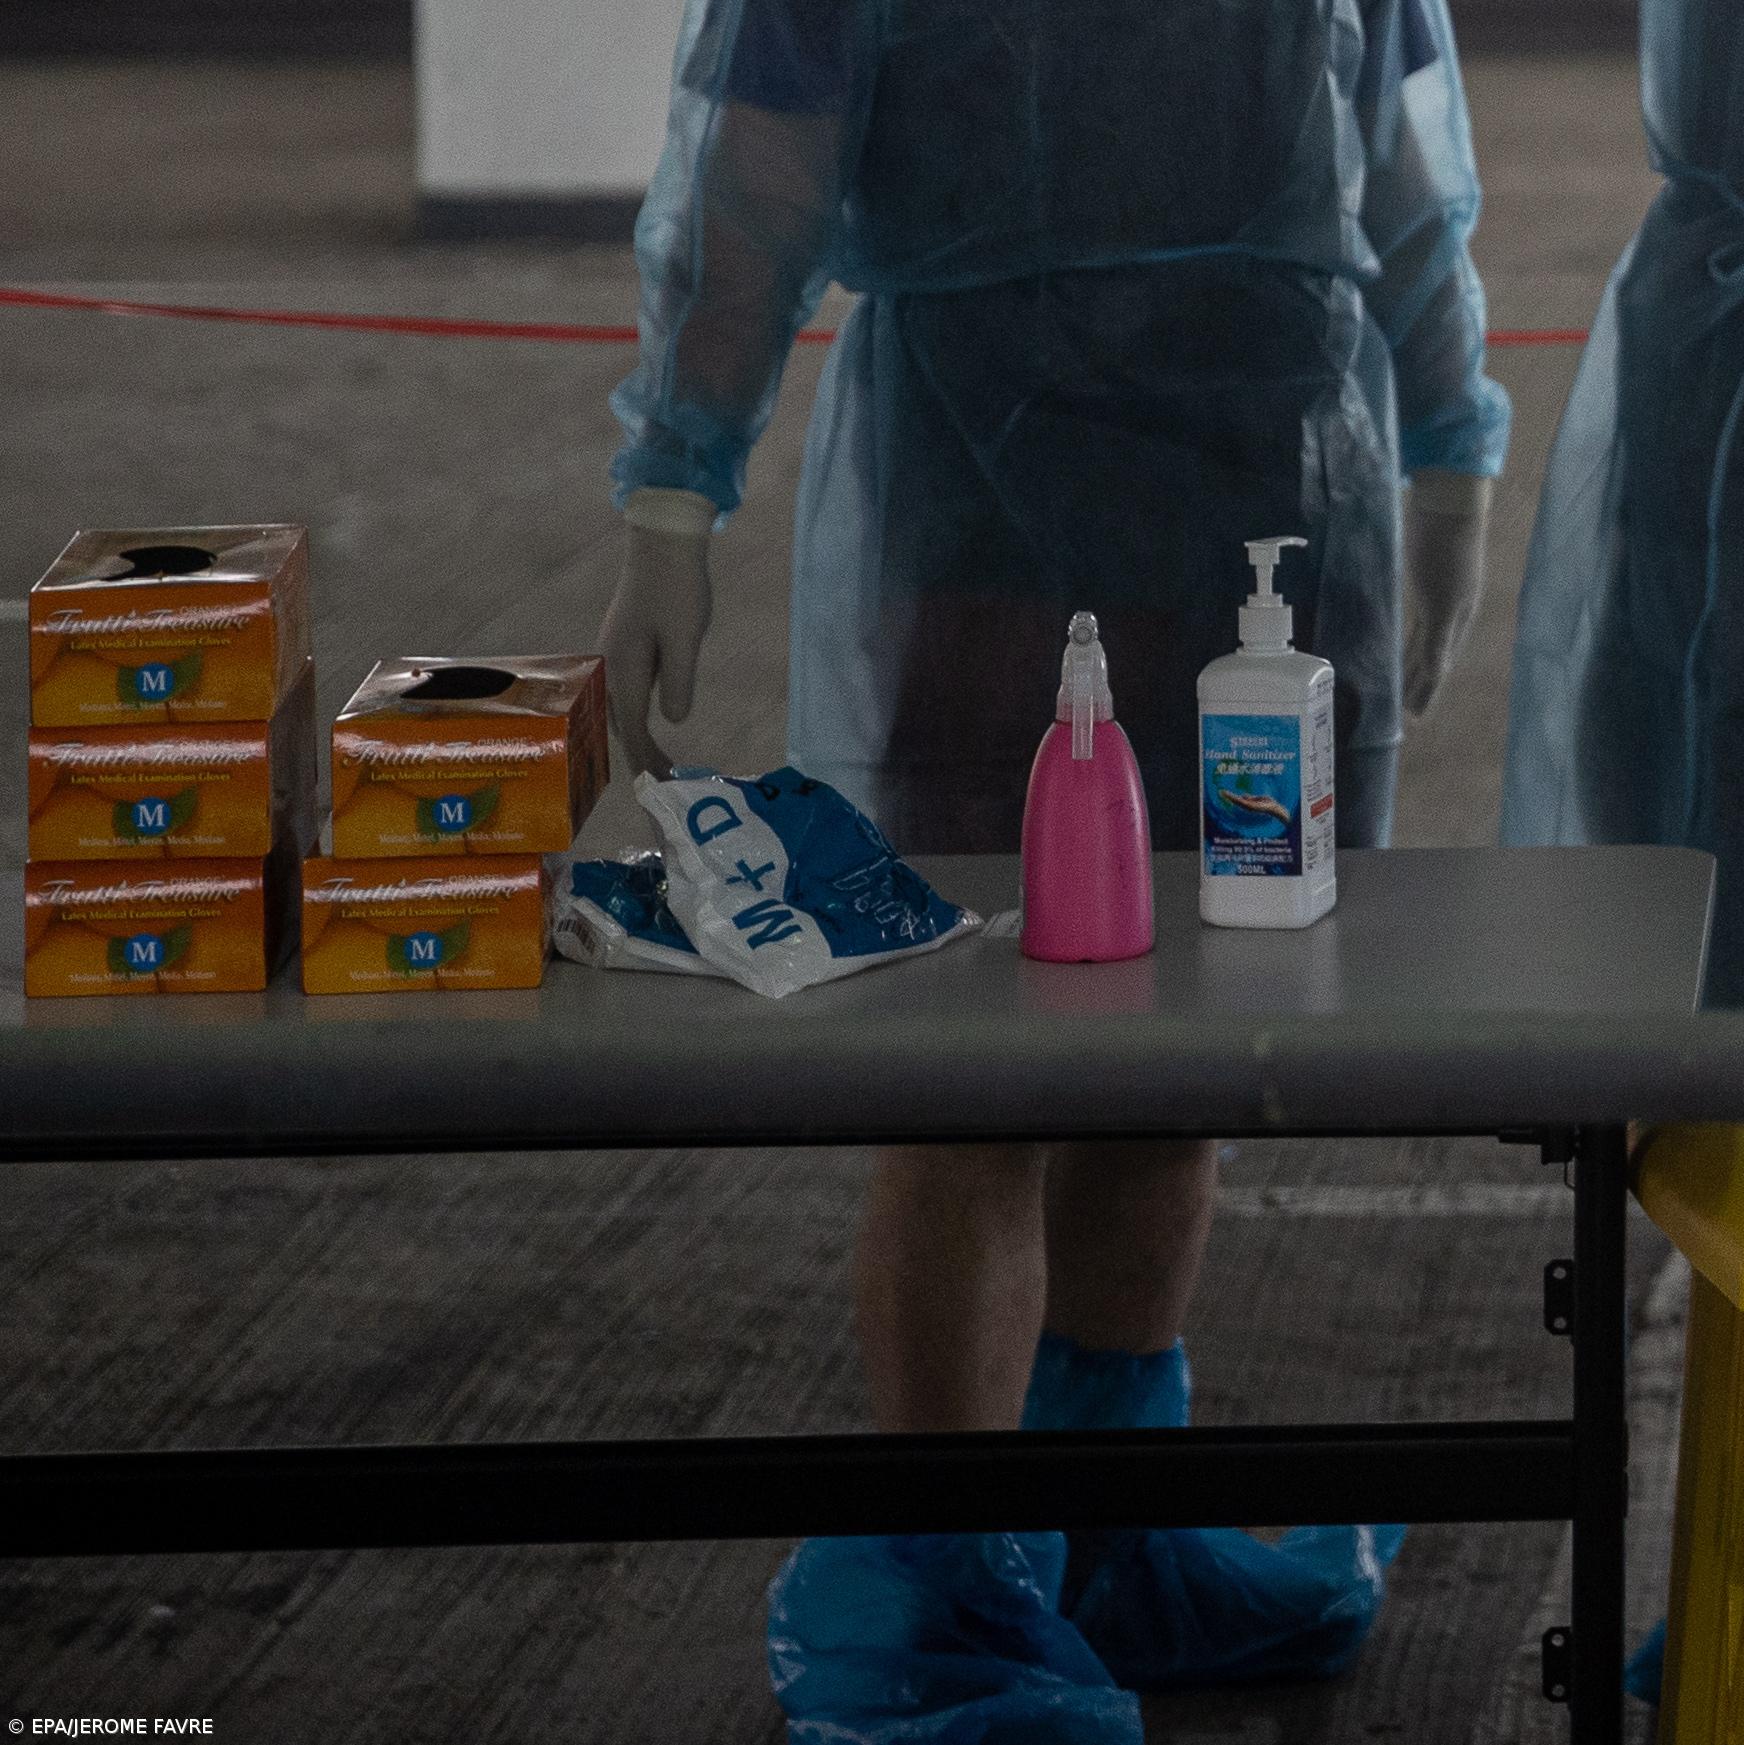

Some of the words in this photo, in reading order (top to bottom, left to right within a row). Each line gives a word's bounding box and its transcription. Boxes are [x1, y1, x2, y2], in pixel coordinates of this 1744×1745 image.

[142, 670, 167, 692] M
[137, 804, 166, 827] M
[440, 801, 465, 823] M
[131, 941, 157, 963] M
[410, 938, 436, 960] M
